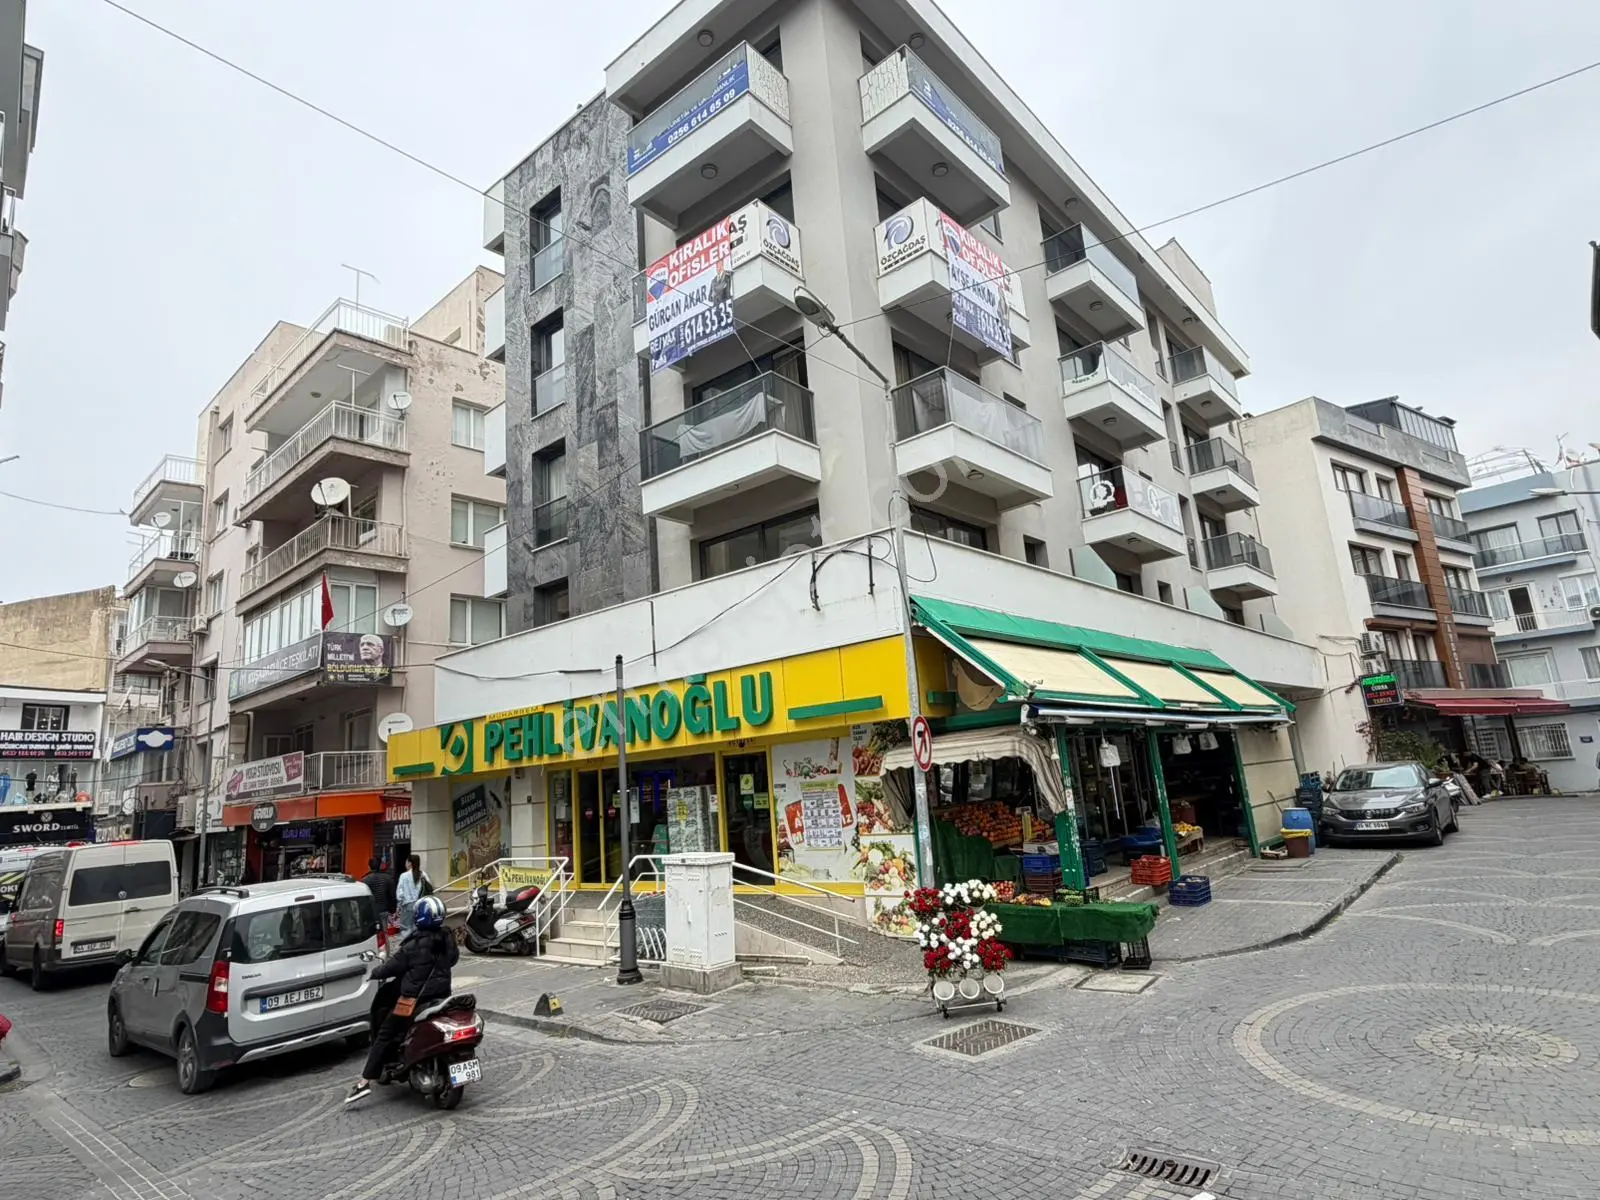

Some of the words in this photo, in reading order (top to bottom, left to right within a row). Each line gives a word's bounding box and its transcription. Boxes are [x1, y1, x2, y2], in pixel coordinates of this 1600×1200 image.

[668, 124, 689, 144] 0256
[691, 110, 708, 127] 614
[709, 99, 722, 113] 65
[723, 89, 736, 103] 09
[668, 221, 728, 269] KİRALIK
[763, 238, 800, 269] ÖZÇAĞDAŞ
[880, 234, 926, 266] ÖZÇAĞDAŞ
[668, 240, 731, 287] OFİSLER
[648, 304, 682, 333] GÜRCAN
[683, 284, 707, 312] AKAR
[684, 313, 704, 345] 614
[705, 307, 719, 335] 35
[720, 300, 733, 328] 35
[288, 643, 319, 668] TEŞKİLATI
[327, 642, 342, 651] TÜRK
[484, 671, 773, 765] PEHLİVANOĞLU
[1, 731, 23, 741] HAIR
[24, 732, 60, 742] DESIGN
[61, 733, 95, 742] STUDIO
[12, 822, 60, 833] SWORD
[393, 824, 412, 840] AVM
[267, 996, 280, 1008] 09
[284, 992, 301, 1005] AEJ
[304, 987, 321, 1000] 862
[450, 1064, 462, 1075] 09
[462, 1060, 478, 1071] ASM
[465, 1069, 480, 1080] 981
